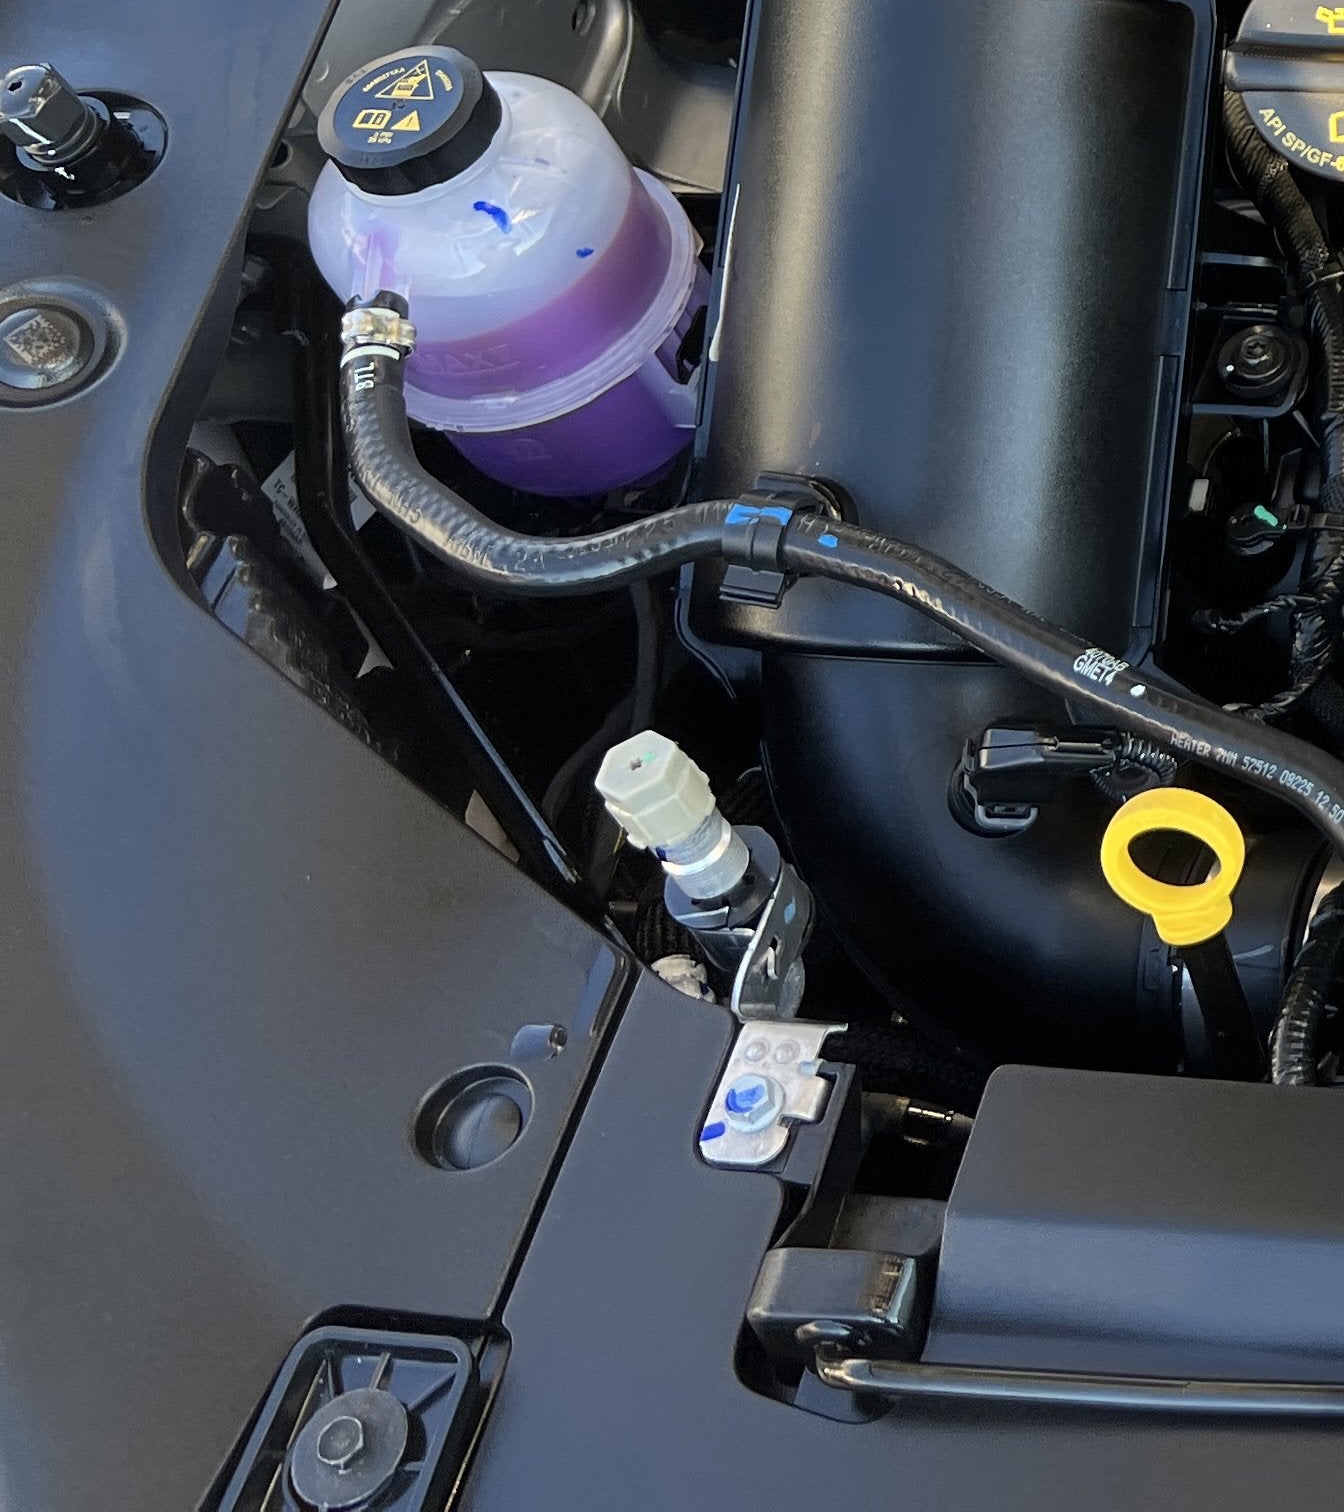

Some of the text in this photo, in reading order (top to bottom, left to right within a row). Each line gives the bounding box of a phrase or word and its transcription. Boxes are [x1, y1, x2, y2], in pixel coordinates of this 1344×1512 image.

[1259, 108, 1287, 136] API
[354, 361, 375, 391] BTL
[1073, 654, 1117, 685] GMET4
[1168, 731, 1213, 758] HEATER
[1239, 754, 1277, 779] 57512
